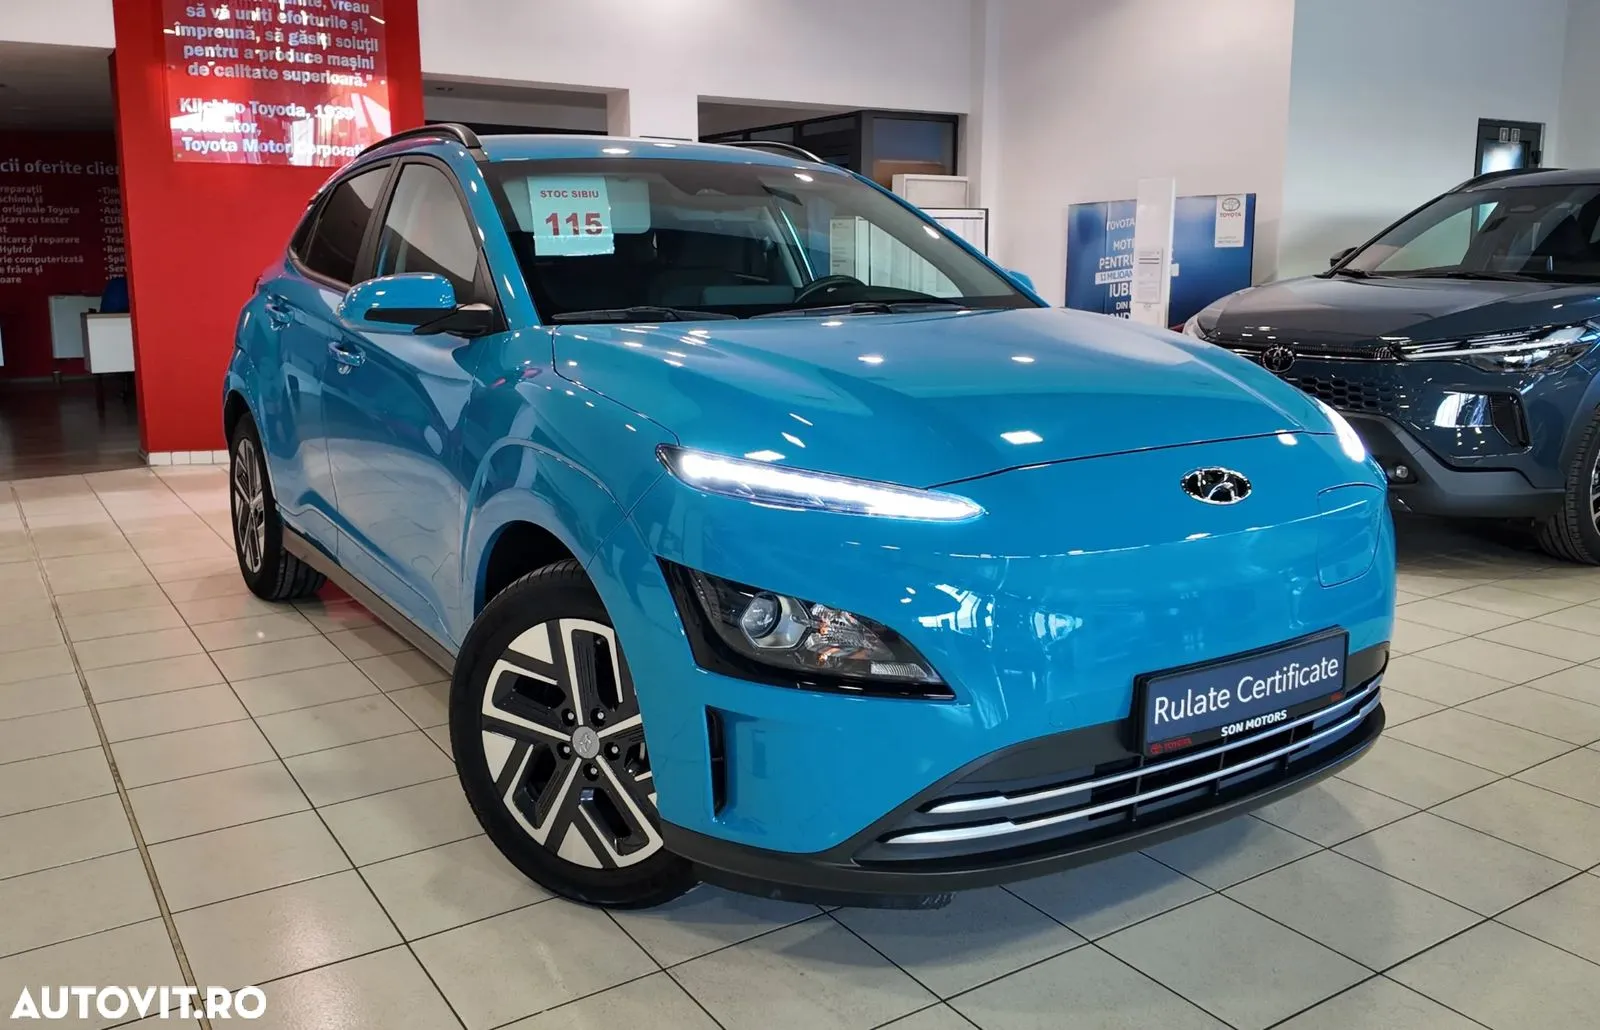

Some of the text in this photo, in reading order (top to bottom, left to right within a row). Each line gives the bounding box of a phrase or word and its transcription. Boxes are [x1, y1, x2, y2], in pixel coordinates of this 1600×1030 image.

[331, 0, 369, 14] vreau
[186, 4, 206, 18] să
[277, 10, 348, 29] eforturile
[174, 21, 260, 43] împreună,
[265, 28, 284, 43] să
[183, 43, 375, 71] pentru a produce mașini
[188, 61, 210, 77] de
[214, 63, 278, 80] calitate
[249, 101, 311, 119] Toyoda,
[181, 136, 238, 154] Toyota
[242, 139, 292, 153] Motor
[24, 160, 82, 175] oferite
[540, 190, 599, 198] STOC SIBIU
[2, 204, 80, 216] originale Toyota
[26, 216, 39, 224] cu
[40, 215, 69, 224] tester
[545, 212, 603, 236] 115
[39, 236, 80, 246] reparare
[6, 265, 33, 275] frâne
[14, 255, 84, 267] computerizată
[1154, 656, 1339, 724] Rulate Certificate
[1221, 709, 1287, 737] SON MOTORS
